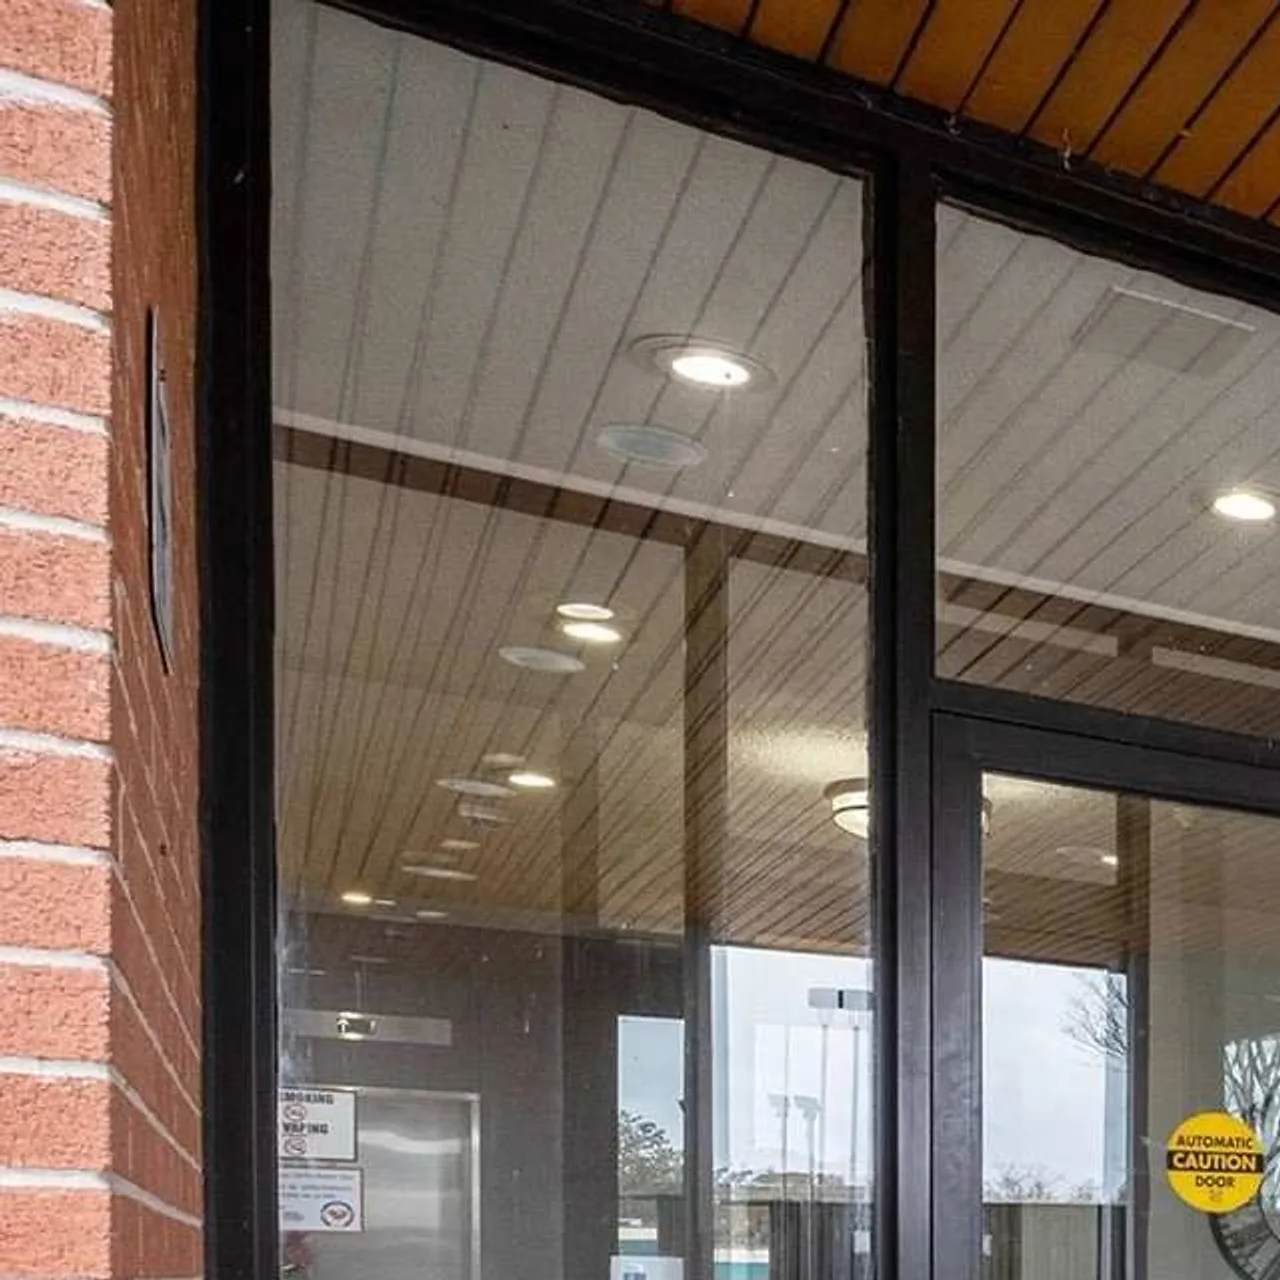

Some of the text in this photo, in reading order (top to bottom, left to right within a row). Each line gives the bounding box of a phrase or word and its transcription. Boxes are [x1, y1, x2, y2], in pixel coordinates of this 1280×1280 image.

[282, 1122, 329, 1134] VAPING
[1176, 1135, 1254, 1150] AUTOMATIC
[1172, 1152, 1257, 1171] CAUTION
[1195, 1175, 1235, 1188] DOOR
